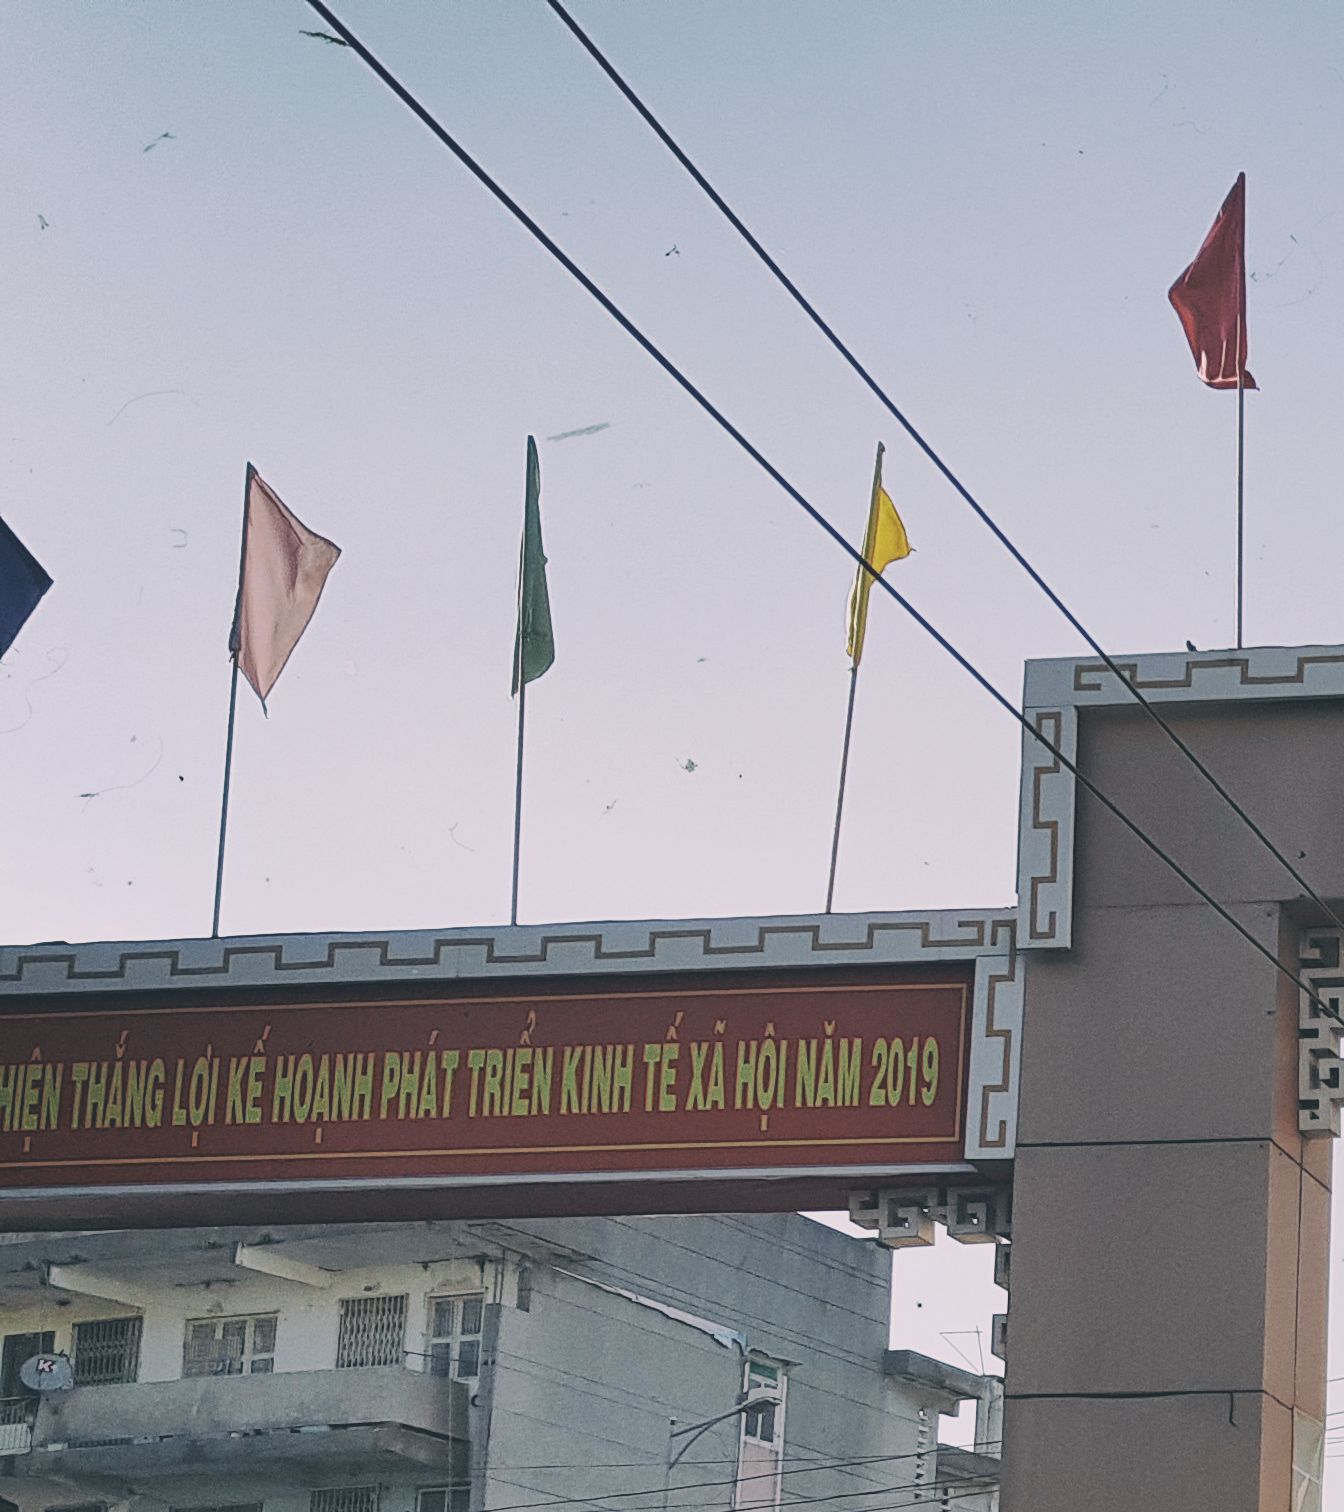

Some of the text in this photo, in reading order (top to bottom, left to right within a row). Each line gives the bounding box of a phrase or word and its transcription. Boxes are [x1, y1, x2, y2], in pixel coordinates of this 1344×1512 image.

[71, 1030, 165, 1129] THẮNG
[172, 1044, 219, 1147] LỢI
[225, 1024, 271, 1125] KẾ
[271, 1052, 374, 1144] HOẠNH
[379, 1029, 459, 1120] PHÁT
[468, 1009, 554, 1118] TRIỂN
[559, 1044, 634, 1115] KINH
[644, 1010, 684, 1112] TẾ
[685, 1020, 726, 1110] XÃ
[735, 1022, 788, 1131] HỘI
[795, 1020, 862, 1108] NĂM
[870, 1036, 939, 1106] 2019
